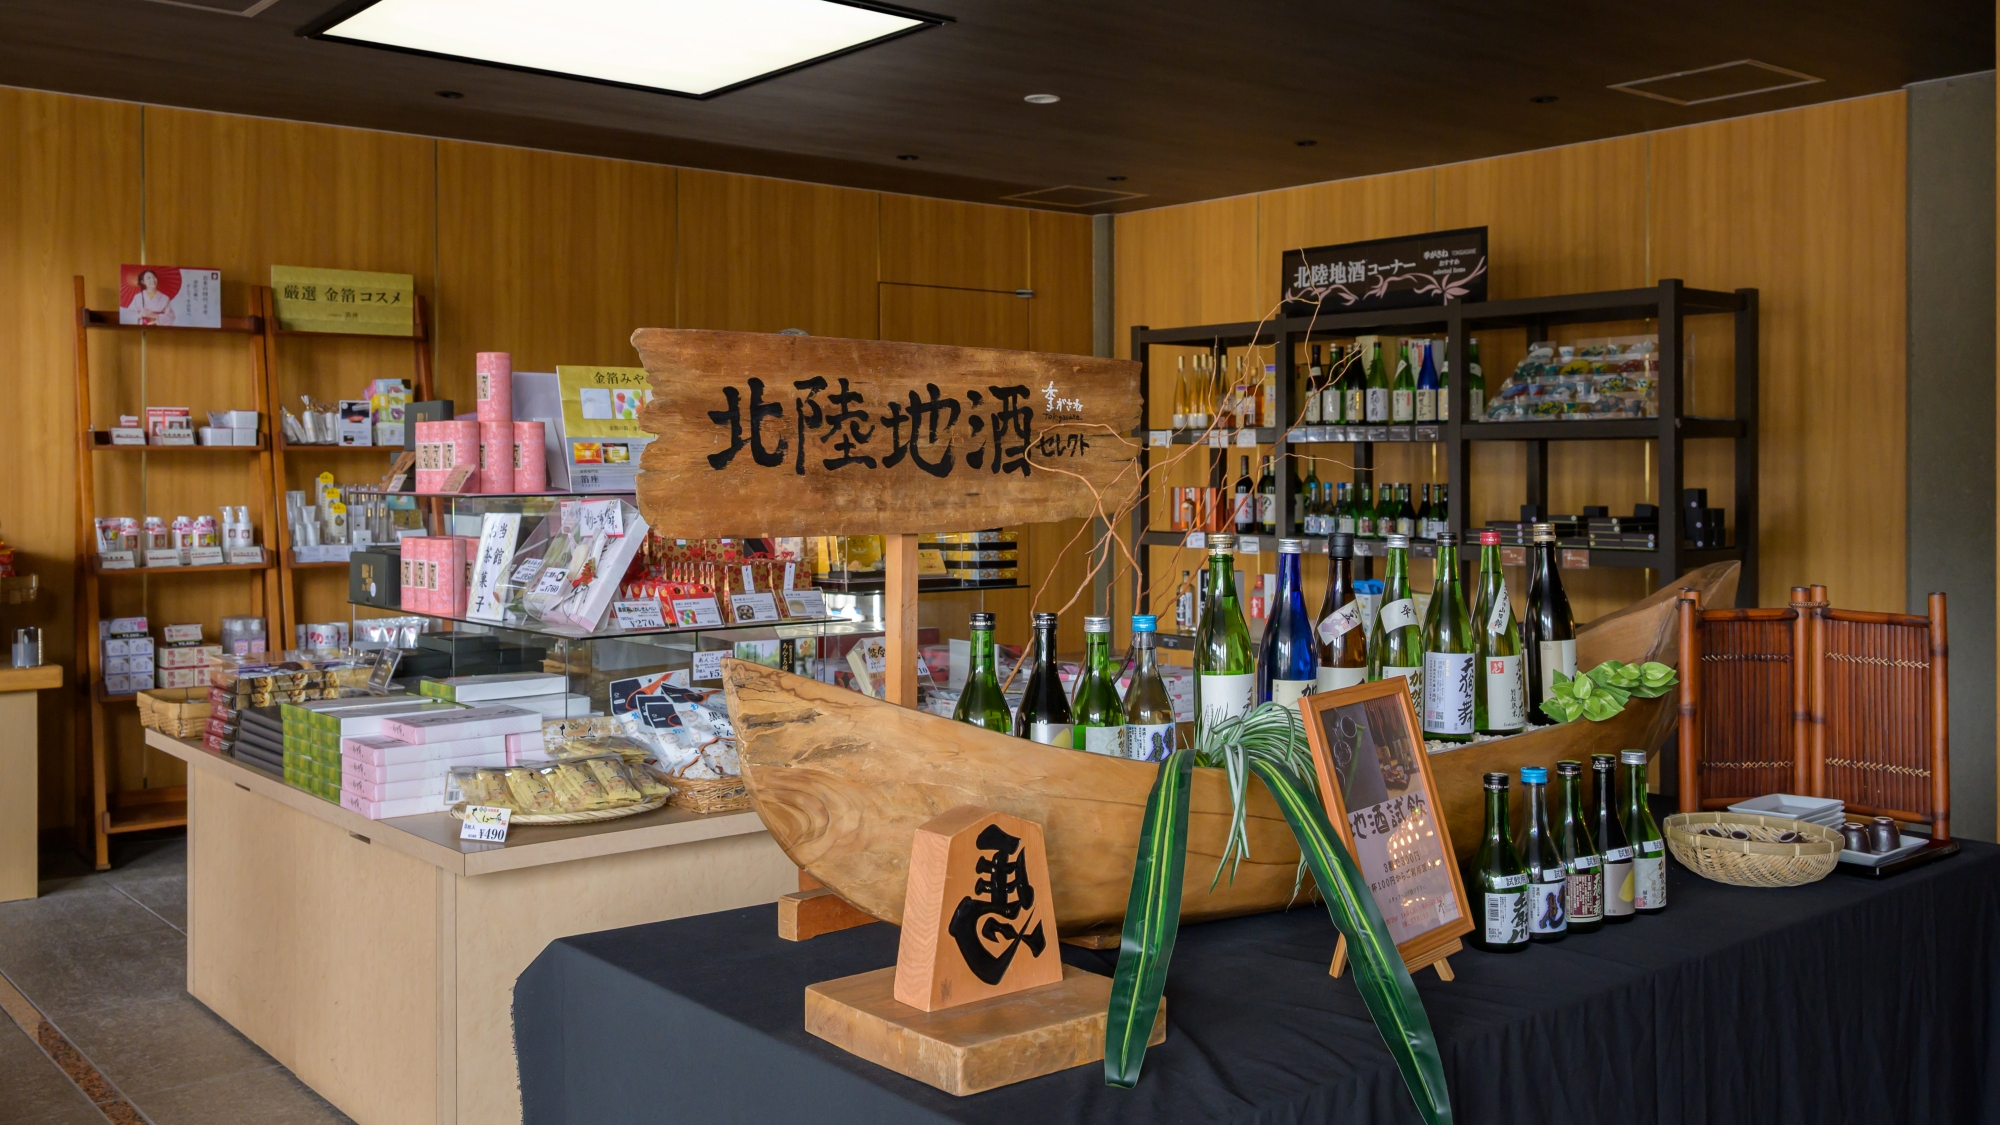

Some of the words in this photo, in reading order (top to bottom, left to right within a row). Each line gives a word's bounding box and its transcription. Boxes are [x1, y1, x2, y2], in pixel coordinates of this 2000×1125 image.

[1293, 259, 1417, 289] 北陸地酒コーナー
[283, 284, 317, 302] 厳選
[325, 287, 401, 305] 金箔コスメ
[707, 375, 1034, 478] 北陸地酒
[1036, 433, 1090, 458] セレクト
[630, 619, 655, 628] ¥270
[1350, 794, 1427, 839] 地酒試飲
[479, 828, 505, 840] ¥490
